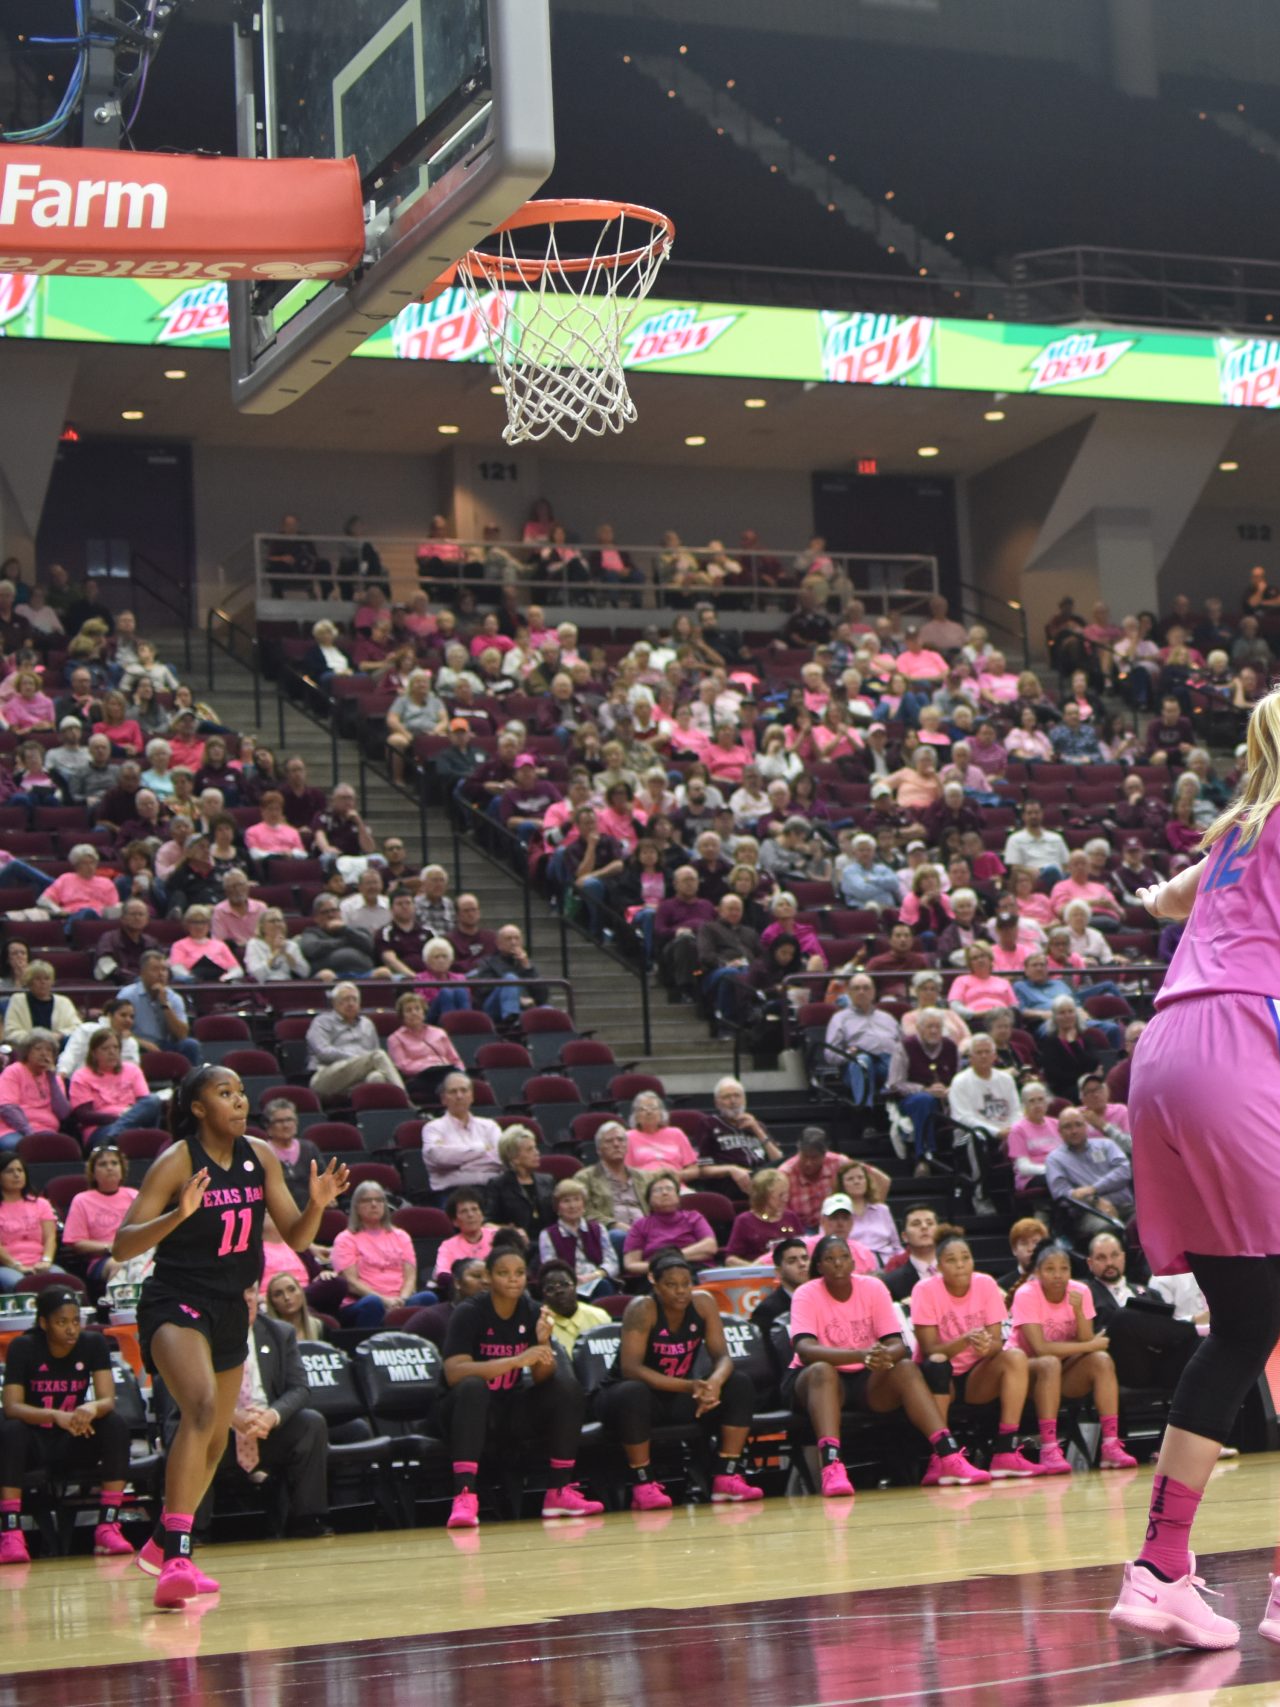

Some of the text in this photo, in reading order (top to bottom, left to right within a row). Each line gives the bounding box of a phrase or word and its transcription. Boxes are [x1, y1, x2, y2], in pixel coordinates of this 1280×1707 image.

[0, 163, 168, 229] Farm
[217, 1207, 252, 1257] 11
[371, 1347, 436, 1366] MUSCLE
[387, 1364, 433, 1382] MILK
[31, 1380, 69, 1392] TEXAS
